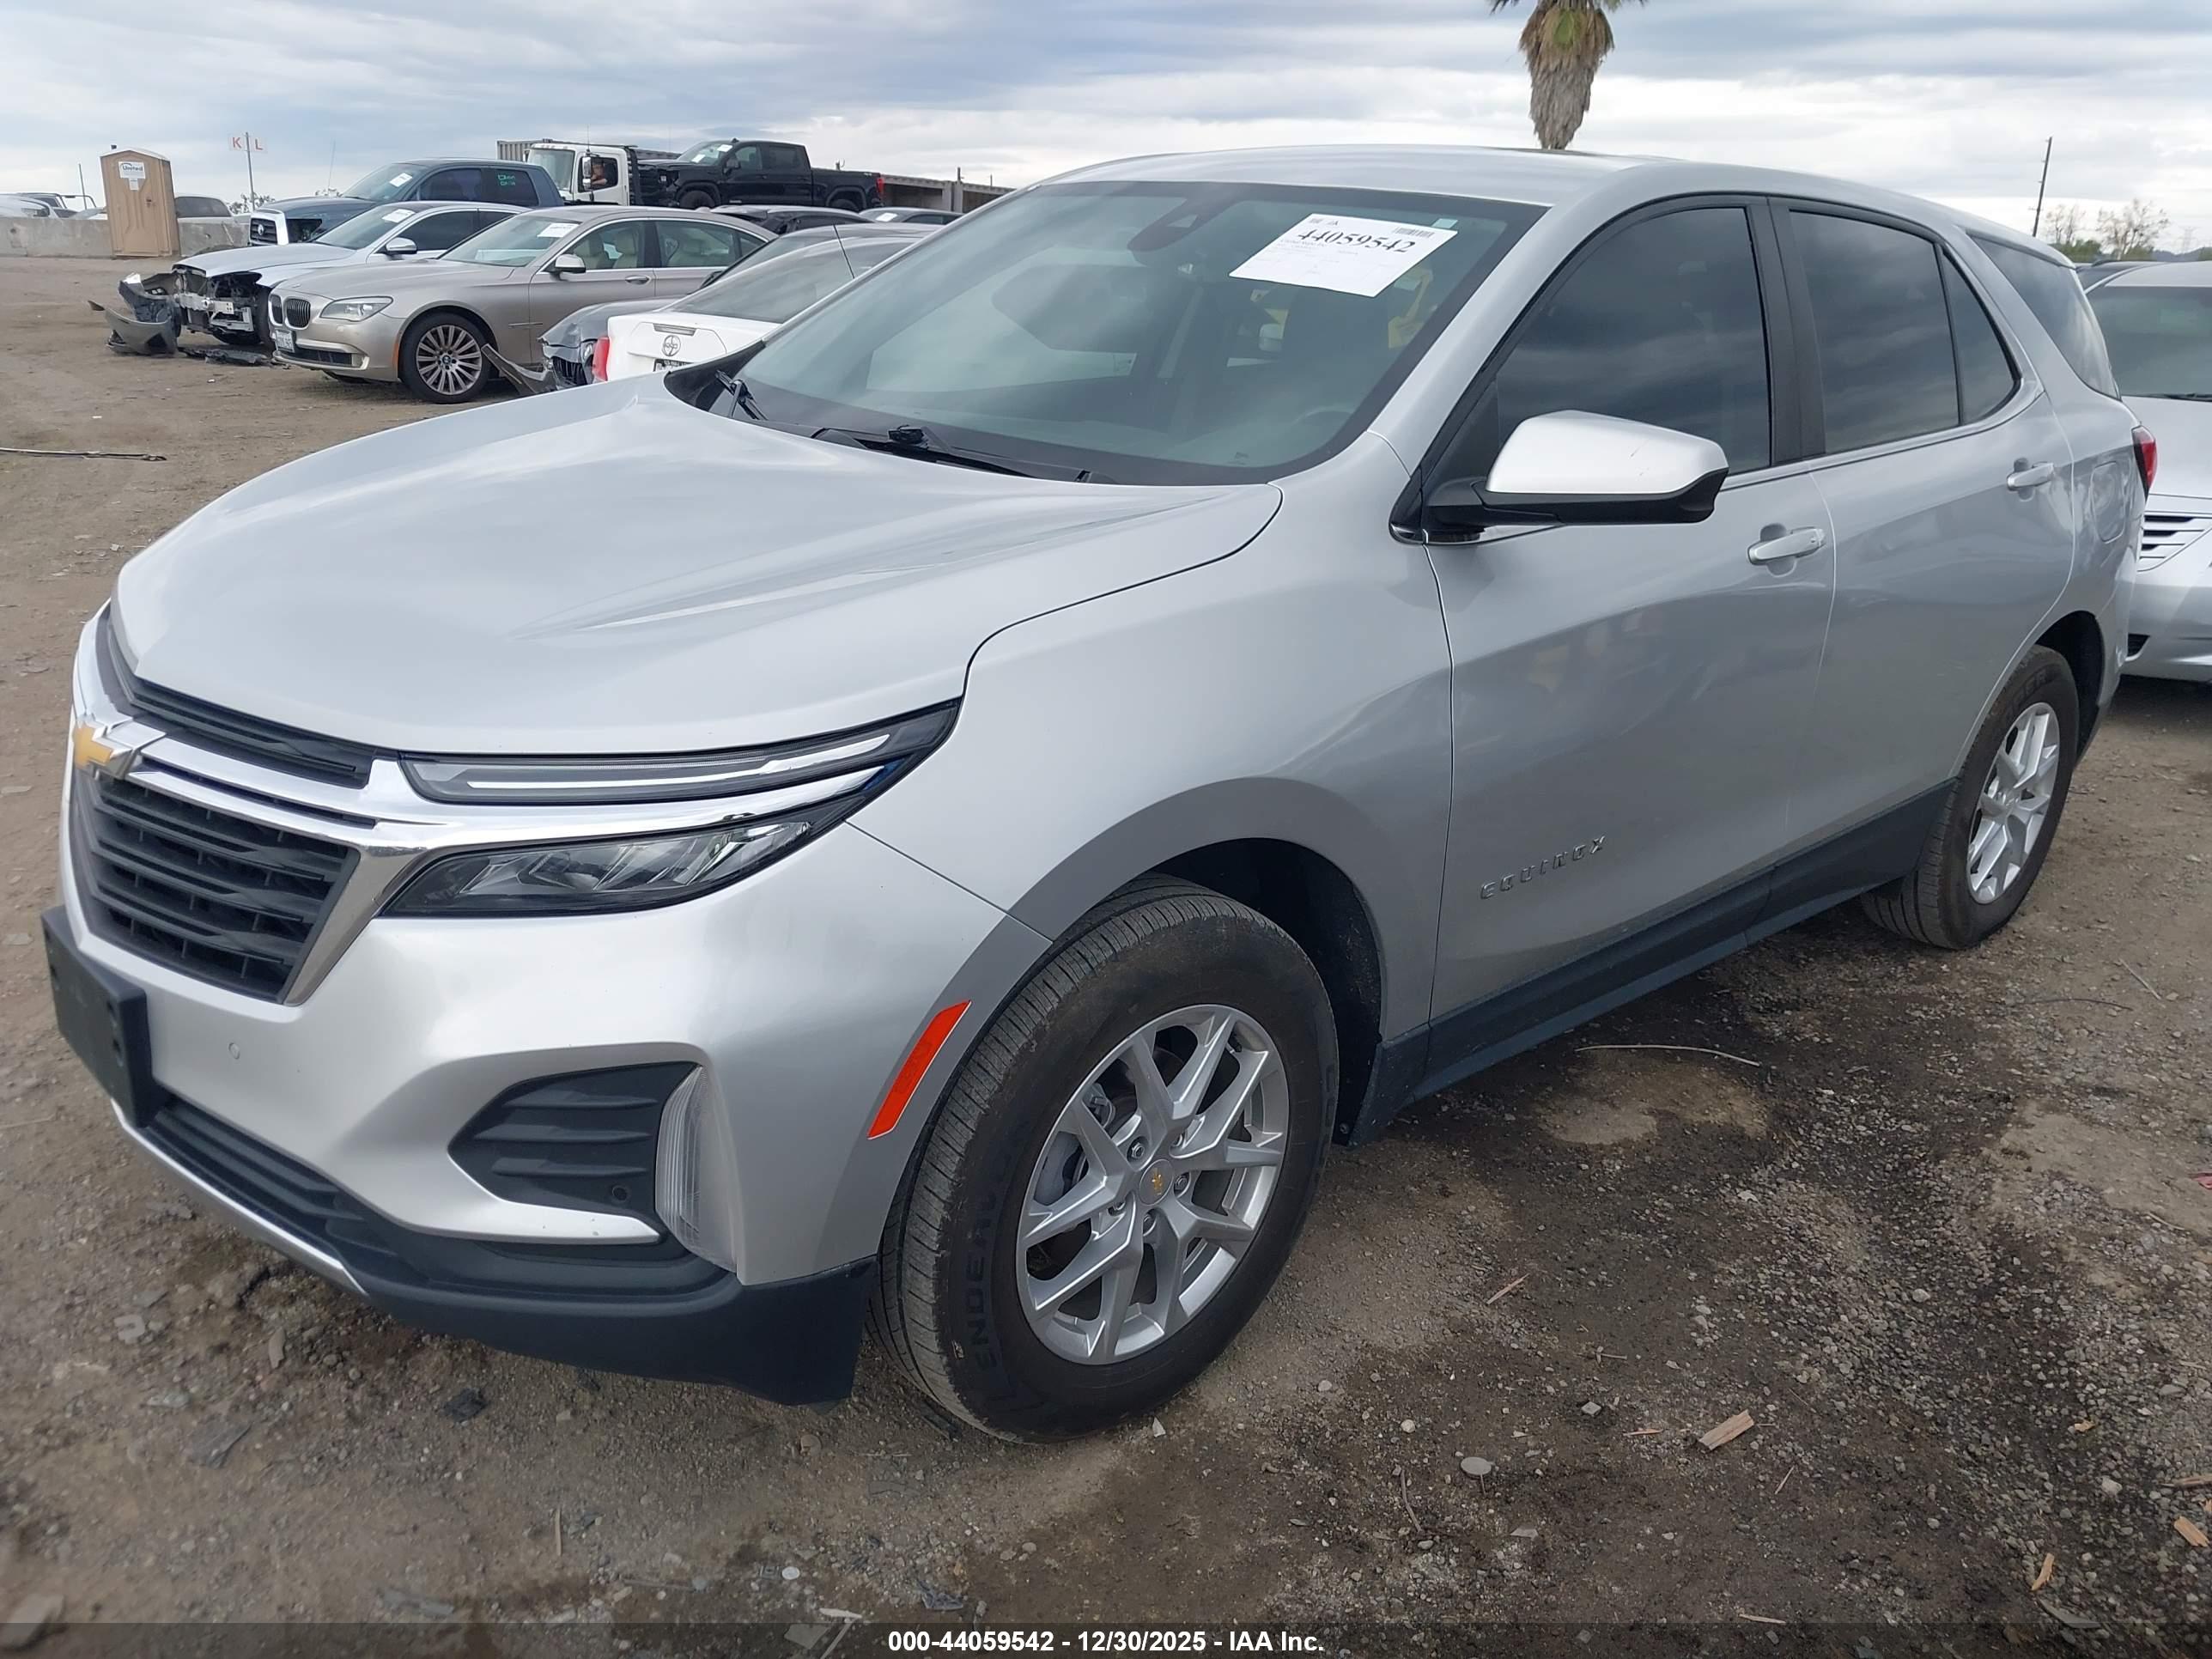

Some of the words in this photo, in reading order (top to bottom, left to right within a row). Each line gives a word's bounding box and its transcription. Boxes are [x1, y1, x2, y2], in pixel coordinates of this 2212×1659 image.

[232, 137, 242, 149] K
[254, 138, 264, 150] L
[1297, 228, 1416, 253] 44059542
[1480, 834, 1607, 900] EQUINOX
